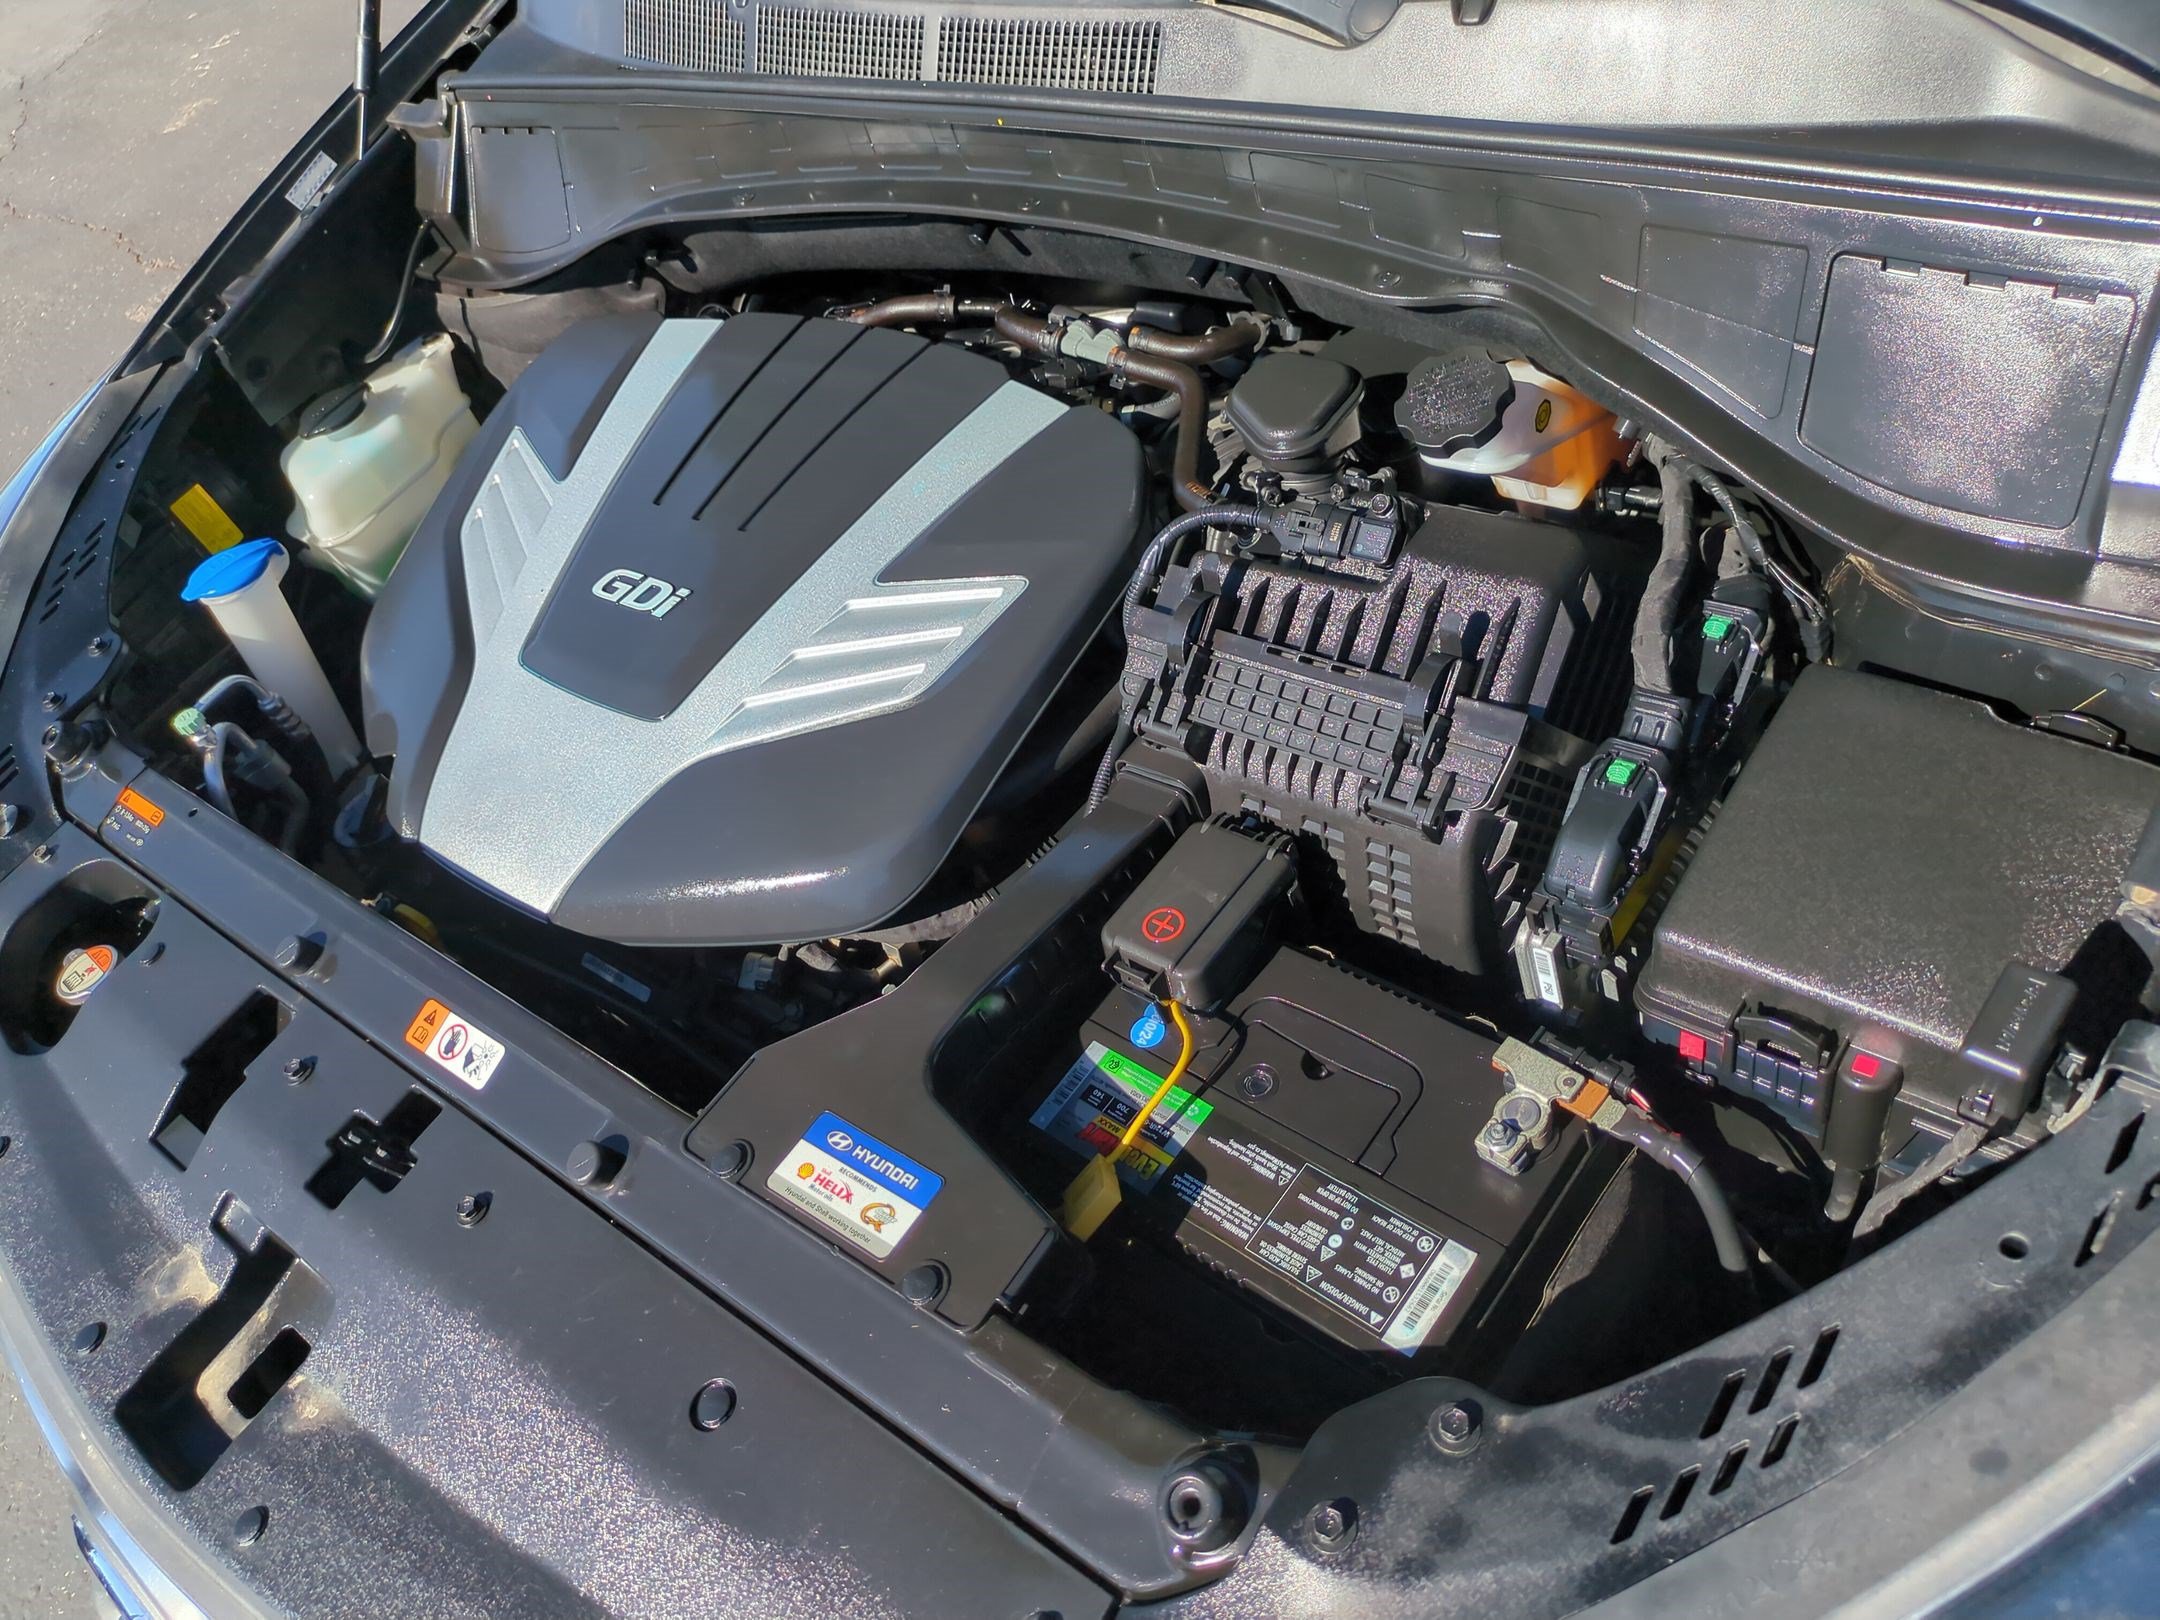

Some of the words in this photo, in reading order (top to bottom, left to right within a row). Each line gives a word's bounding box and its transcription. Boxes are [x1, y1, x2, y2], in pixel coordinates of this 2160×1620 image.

[592, 569, 692, 618] GDi
[1091, 1088, 1106, 1099] 140
[1115, 1101, 1130, 1114] 700
[1096, 1116, 1121, 1134] MAXX
[1230, 1149, 1240, 1158] and
[850, 1144, 920, 1191] HYUNDAI
[837, 1165, 878, 1193] RECOMMENDS
[807, 1183, 826, 1197] Motor
[812, 1172, 857, 1204] HELIX
[1315, 1186, 1330, 1197] OPEN
[1326, 1182, 1346, 1197] BATTERY
[1343, 1191, 1358, 1203] LEAD
[1340, 1199, 1352, 1210] NOT
[1349, 1204, 1359, 1214] DO
[783, 1186, 807, 1203] Hyundai
[804, 1198, 817, 1209] and
[814, 1204, 829, 1217] Shell
[825, 1212, 850, 1231] working
[846, 1225, 872, 1245] together
[1370, 1214, 1388, 1227] REACH
[1218, 1218, 1249, 1240] WARNING:
[1388, 1216, 1413, 1233] CHILDREN
[1296, 1229, 1308, 1238] CAN
[1392, 1226, 1404, 1236] OUT
[1401, 1231, 1415, 1242] KEEP
[1370, 1234, 1385, 1246] HELP
[1258, 1247, 1270, 1257] CAN
[1372, 1243, 1384, 1253] GET
[1267, 1253, 1280, 1263] ACID
[1365, 1254, 1379, 1266] EYES
[1333, 1263, 1354, 1278] FLAMES
[1376, 1261, 1394, 1275] FLUSH
[1353, 1266, 1377, 1283] SMOKING
[1374, 1278, 1384, 1288] OR
[1369, 1285, 1380, 1294] NO
[1318, 1279, 1369, 1315] DANGER/POISON
